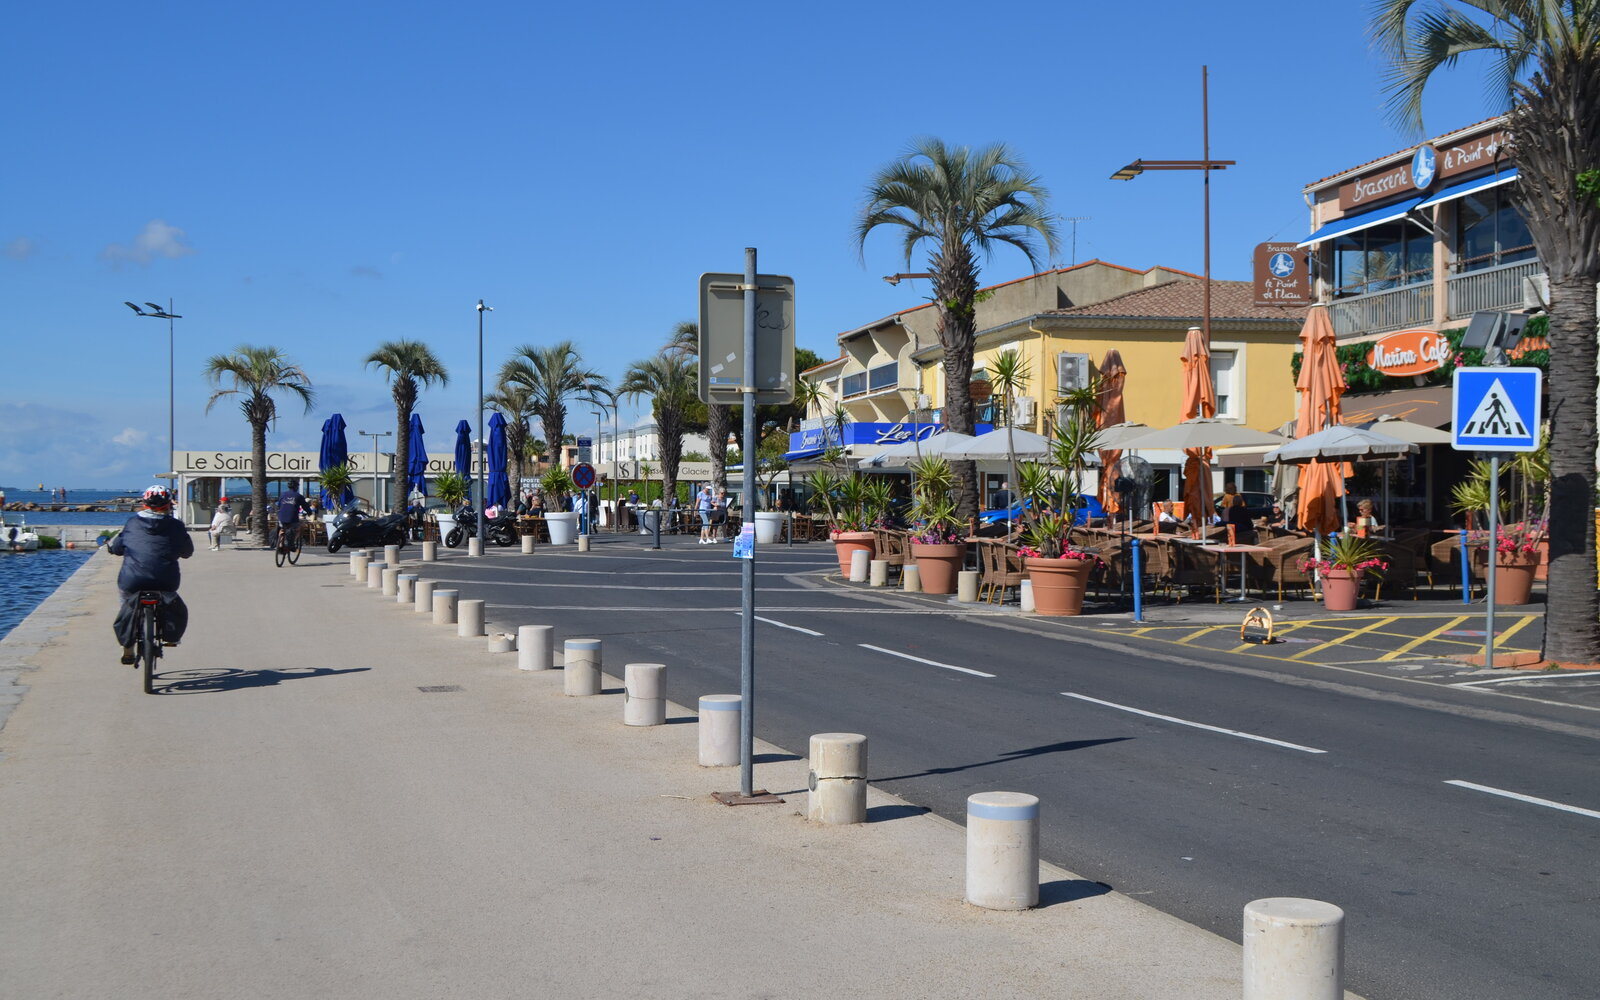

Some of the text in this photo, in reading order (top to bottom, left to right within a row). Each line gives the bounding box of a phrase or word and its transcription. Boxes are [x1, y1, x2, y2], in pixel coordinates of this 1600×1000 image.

[1352, 167, 1408, 202] Brasserie
[1443, 151, 1454, 170] le
[1452, 142, 1484, 167] Point
[1272, 277, 1298, 288] Point
[1371, 336, 1450, 370] Marina Café
[875, 424, 913, 444] Les
[186, 452, 311, 470] Le Sain Clair
[681, 466, 710, 475] Glacier
